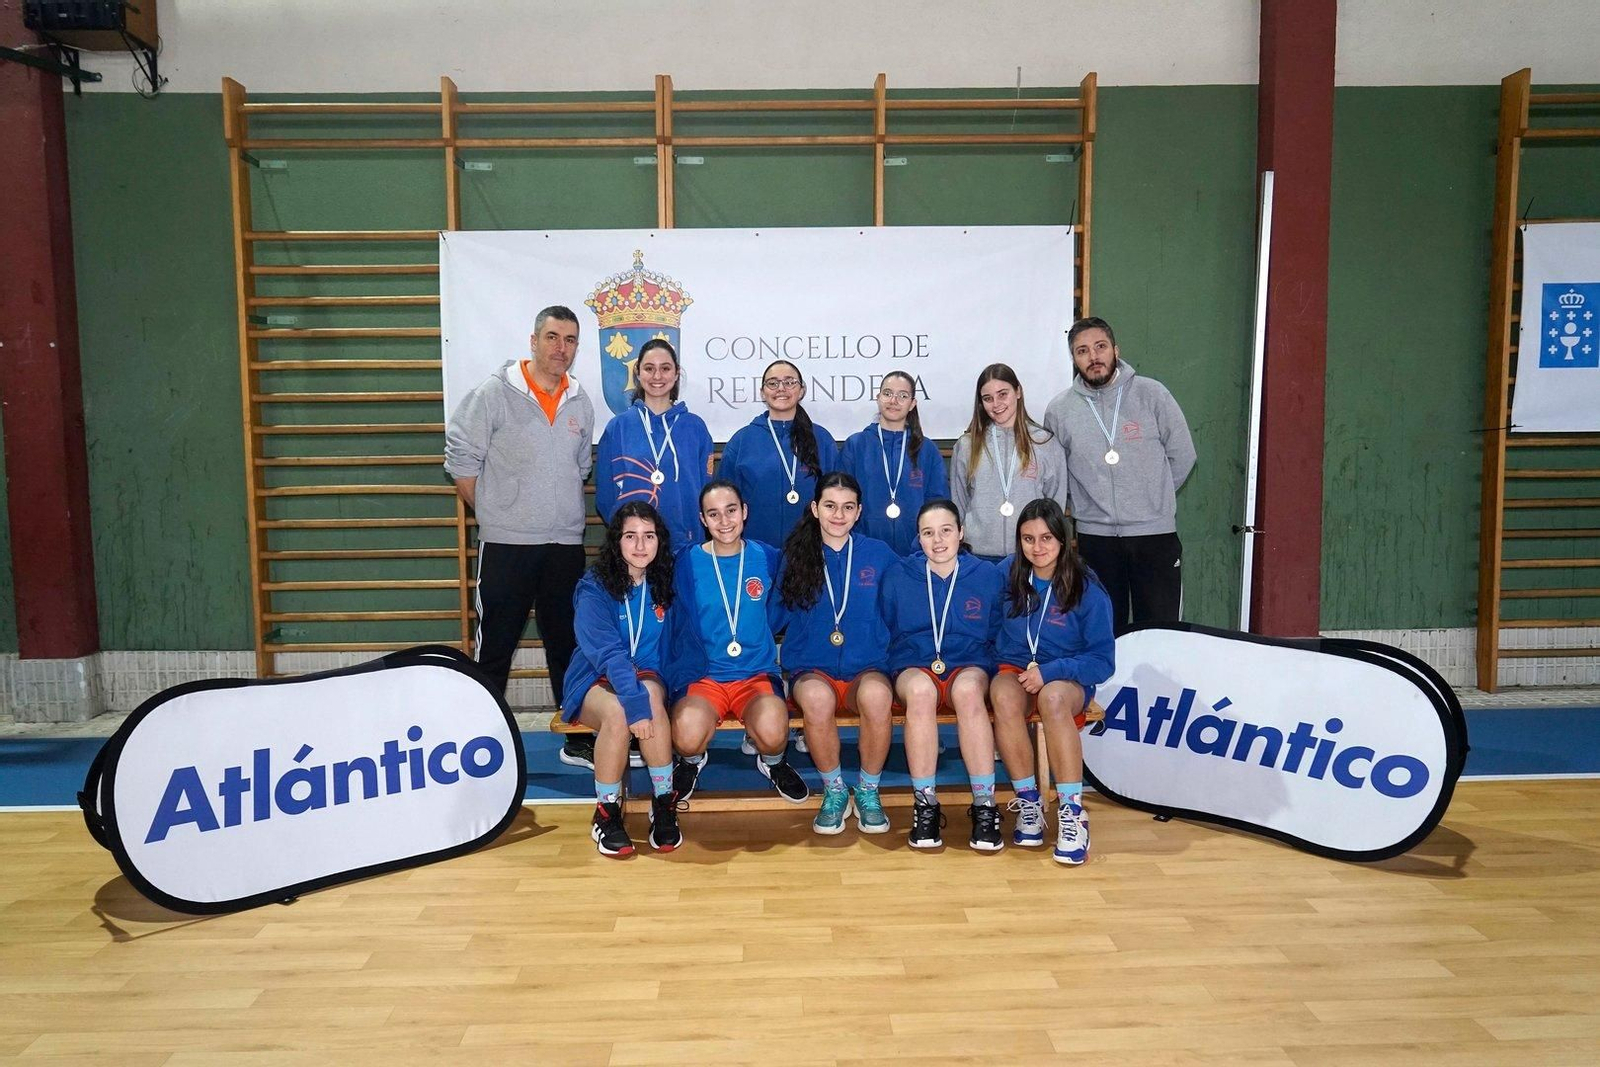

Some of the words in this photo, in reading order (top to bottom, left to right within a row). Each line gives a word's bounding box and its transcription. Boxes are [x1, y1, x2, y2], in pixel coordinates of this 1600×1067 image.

[705, 335, 881, 360] CONCELLO
[892, 334, 930, 358] DE
[707, 374, 931, 409] RENDEA
[1090, 686, 1430, 799] Atlántico
[143, 725, 504, 844] Atlántico
